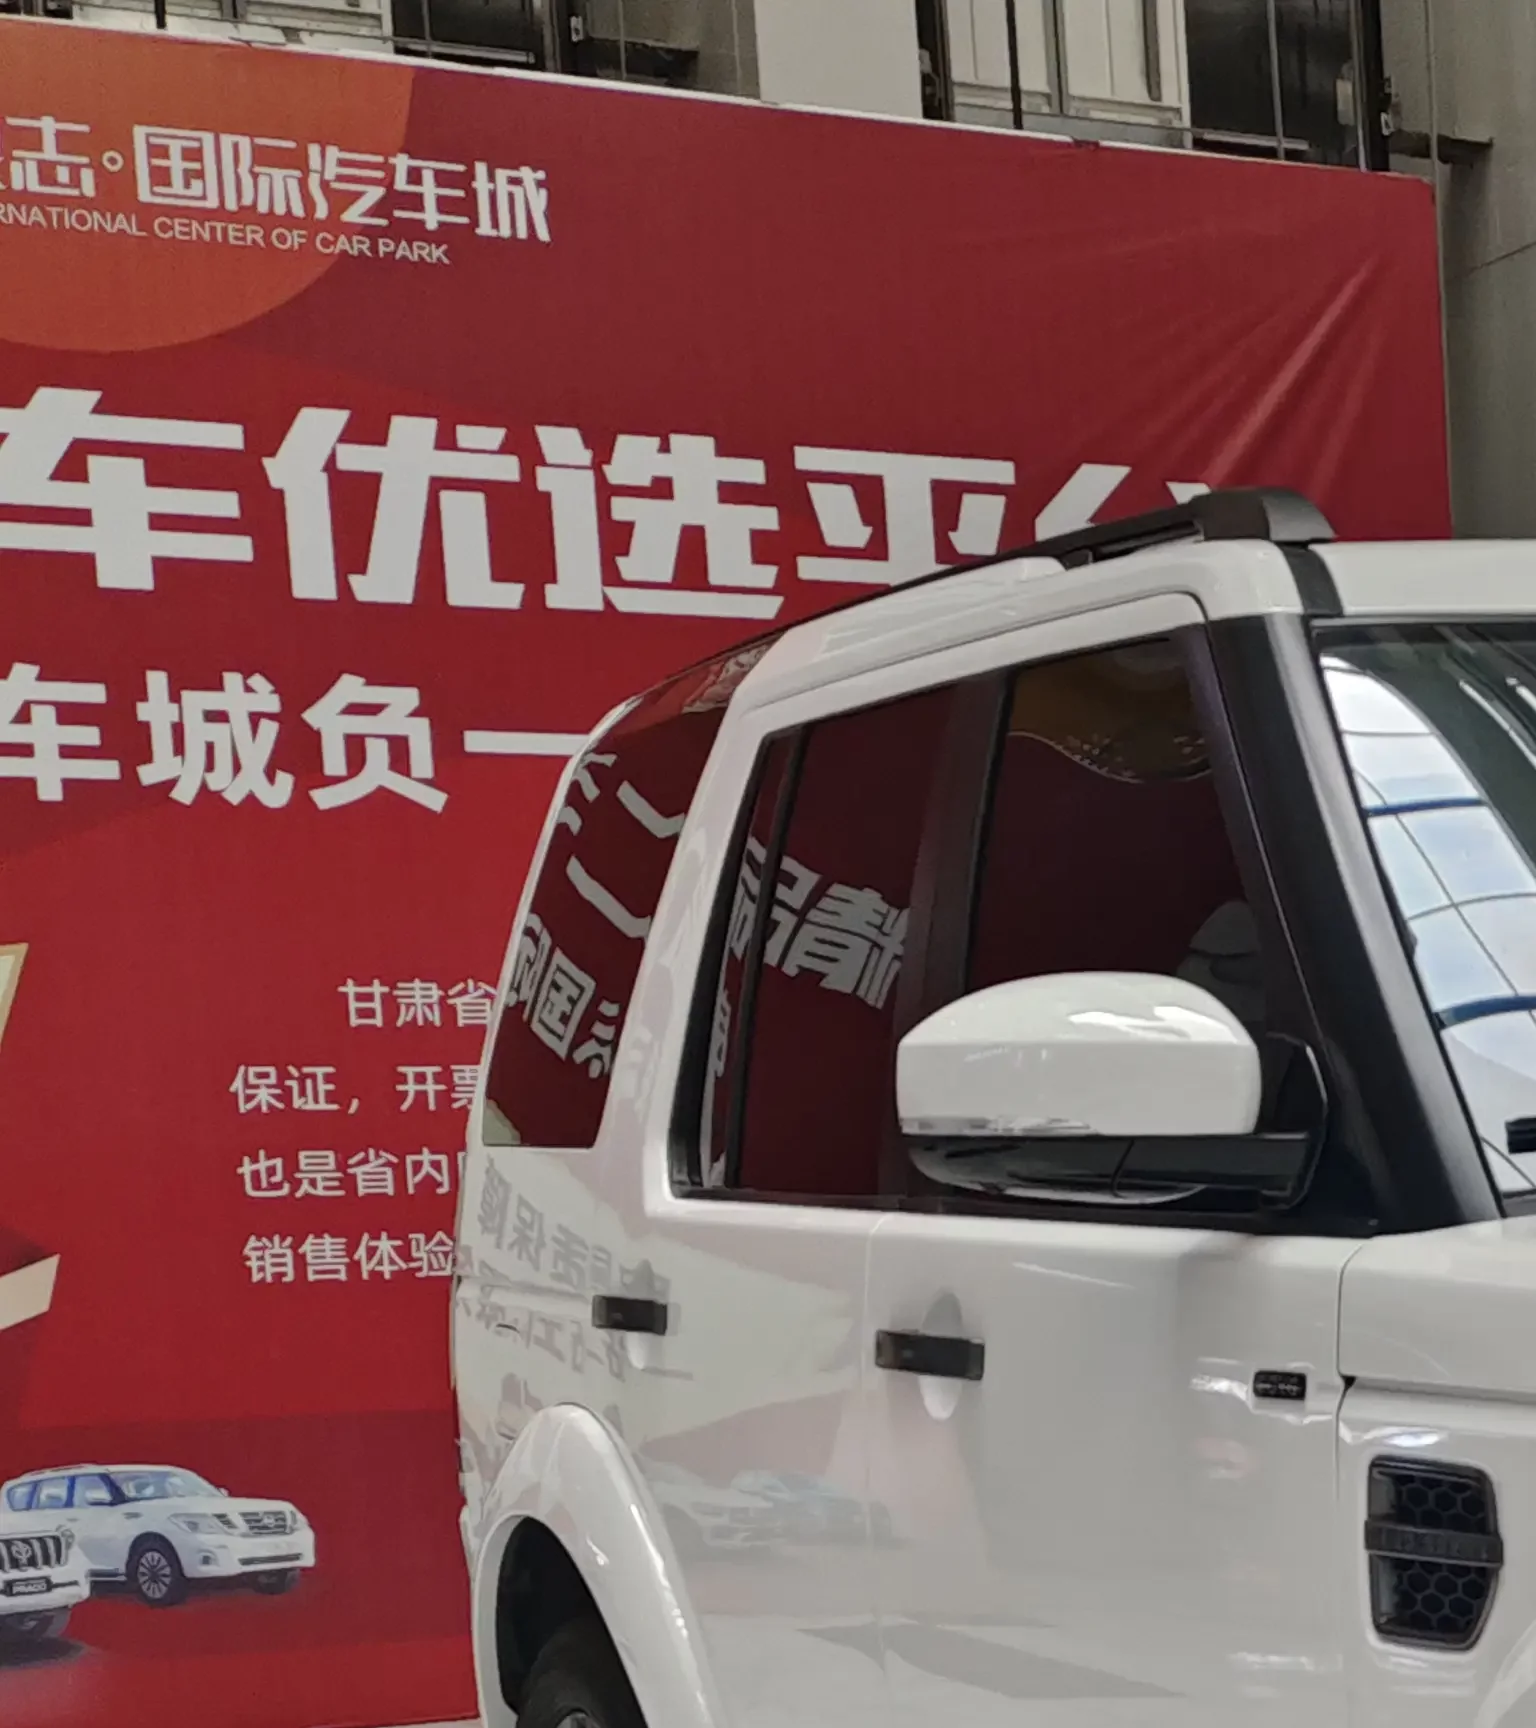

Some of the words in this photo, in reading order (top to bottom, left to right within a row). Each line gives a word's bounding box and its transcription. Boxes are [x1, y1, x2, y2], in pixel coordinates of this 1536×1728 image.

[0, 116, 551, 242] 志·国际汽车城
[153, 216, 266, 248] CENTER
[271, 228, 308, 250] OF
[315, 233, 372, 258] CAR
[378, 239, 450, 264] PARK
[338, 978, 498, 1027] 甘肃省
[236, 1147, 467, 1198] 也是省内
[243, 1231, 455, 1284] 销售体验
